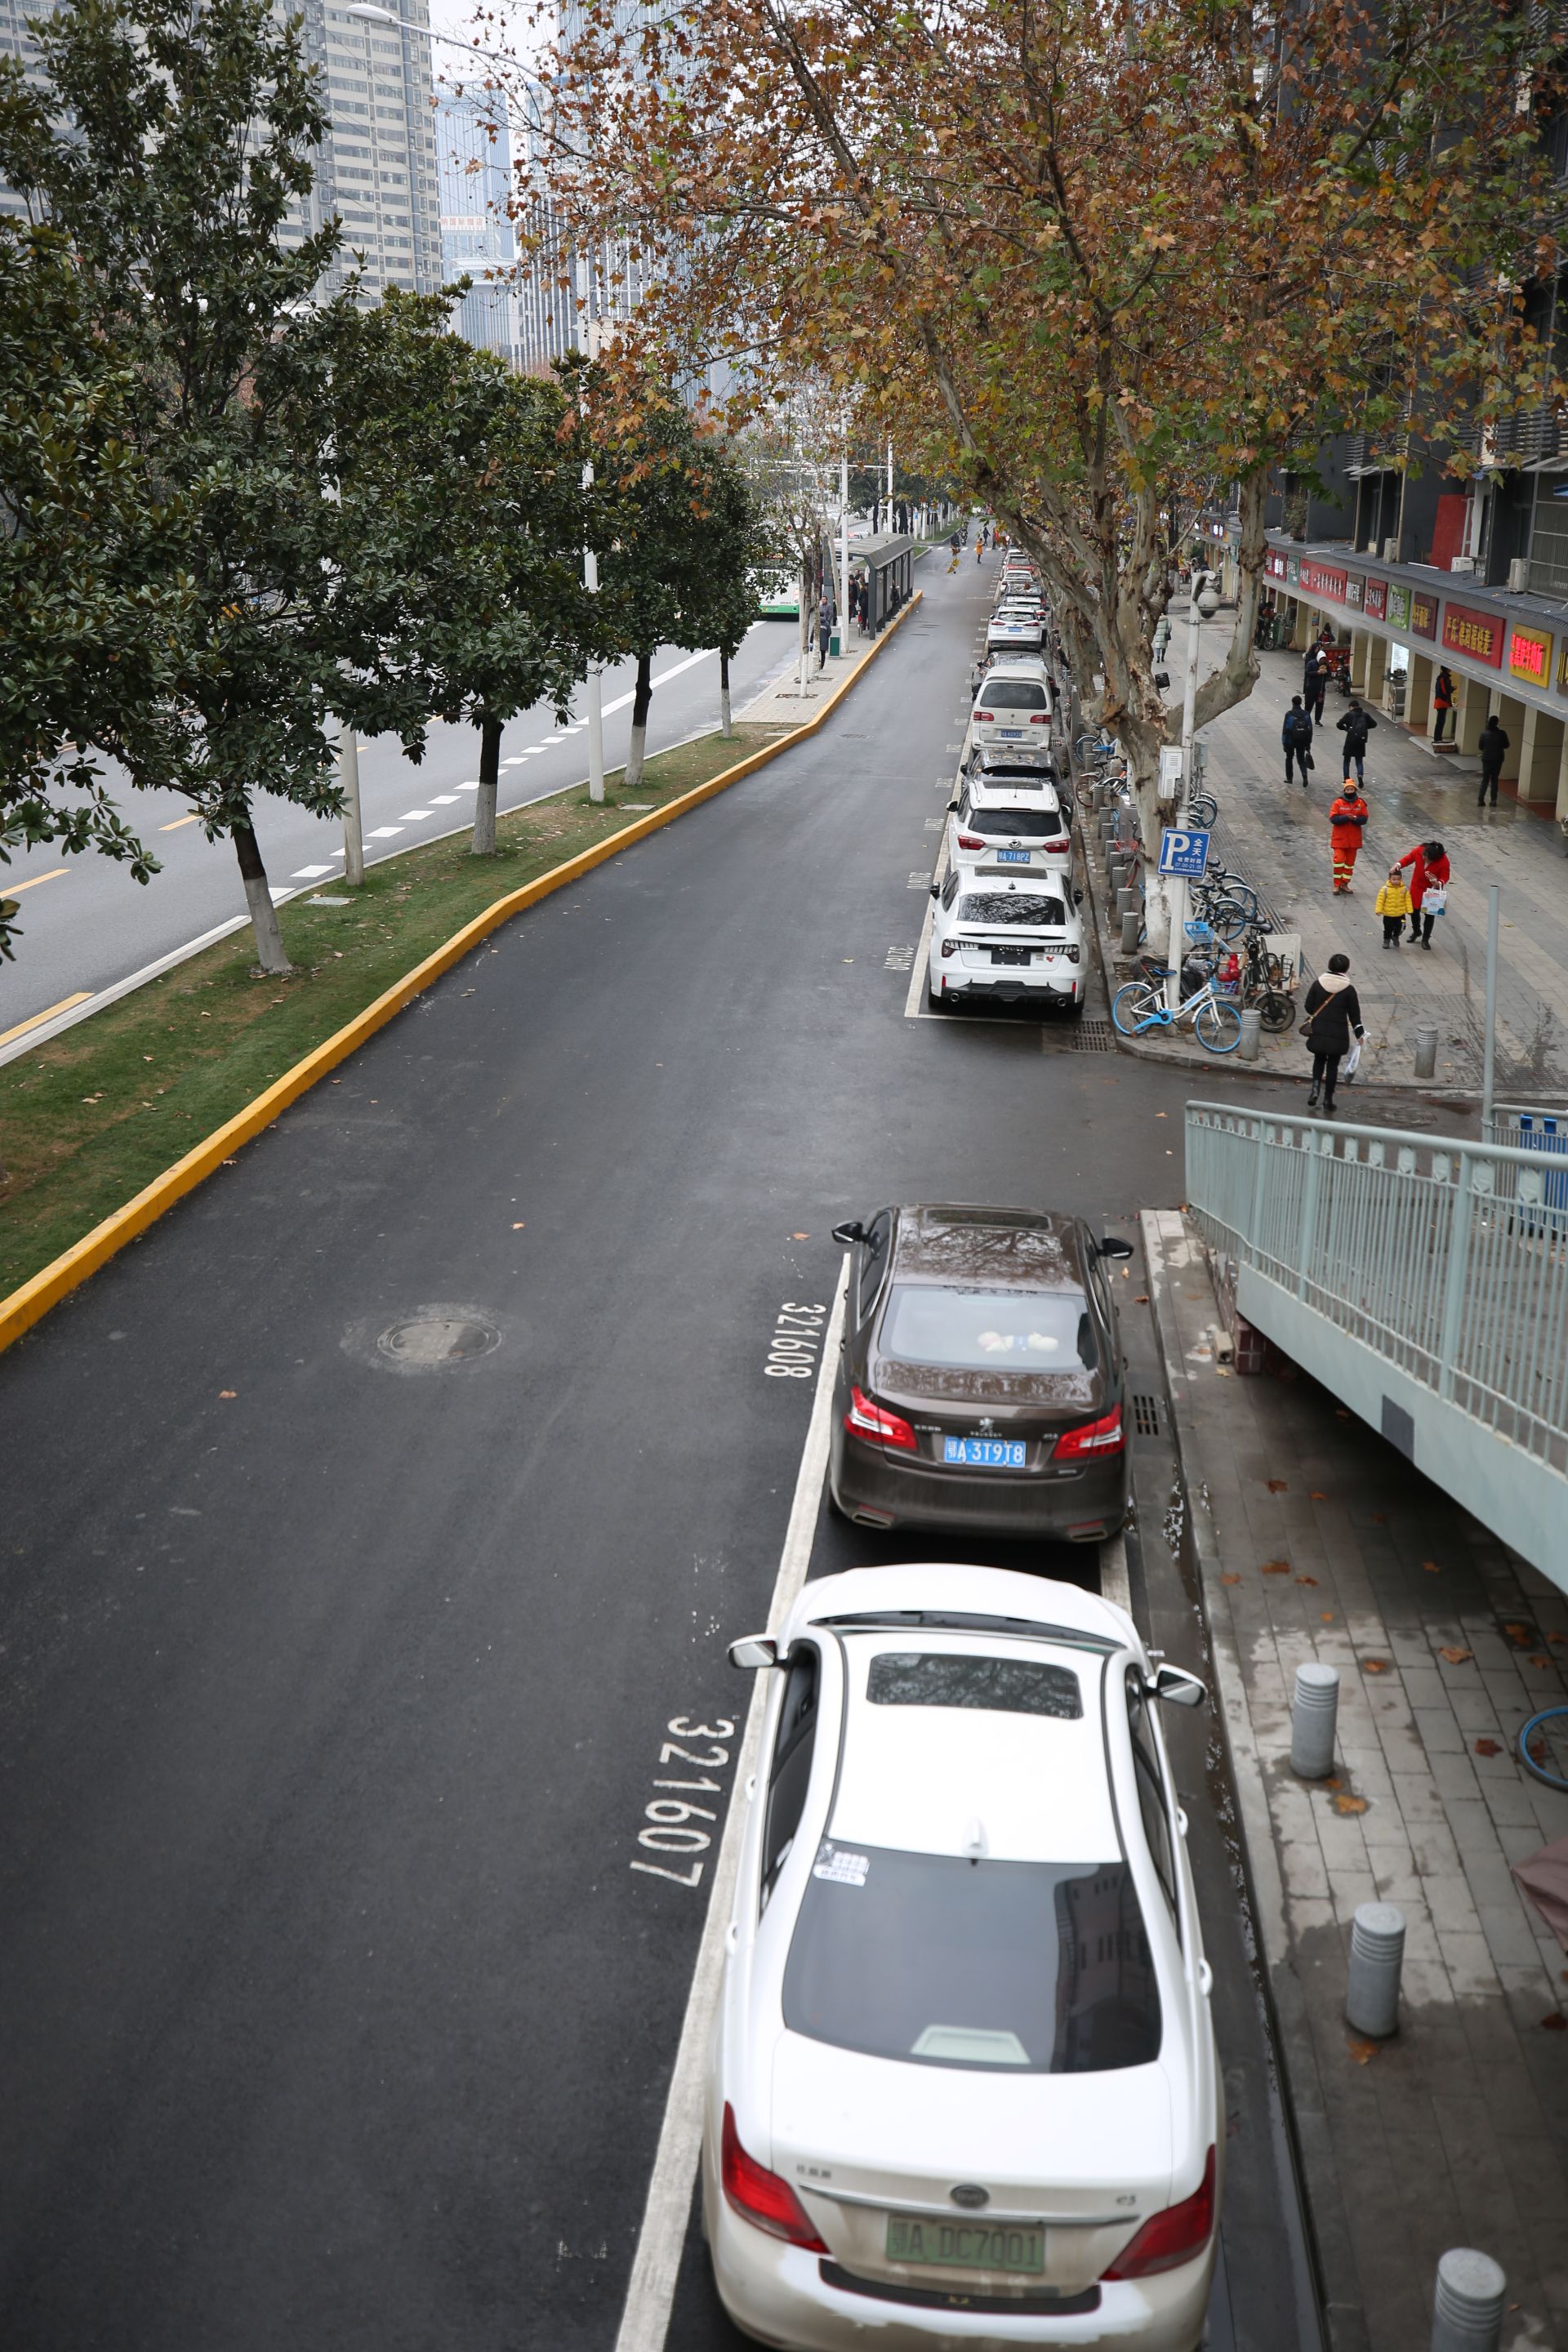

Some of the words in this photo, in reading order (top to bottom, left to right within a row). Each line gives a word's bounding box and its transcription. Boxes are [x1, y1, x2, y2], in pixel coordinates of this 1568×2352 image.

[1161, 833, 1190, 871] P
[1192, 839, 1203, 856] 全天
[883, 947, 915, 971] 321609
[764, 1302, 826, 1379] 321608
[630, 1716, 735, 1888] 321607
